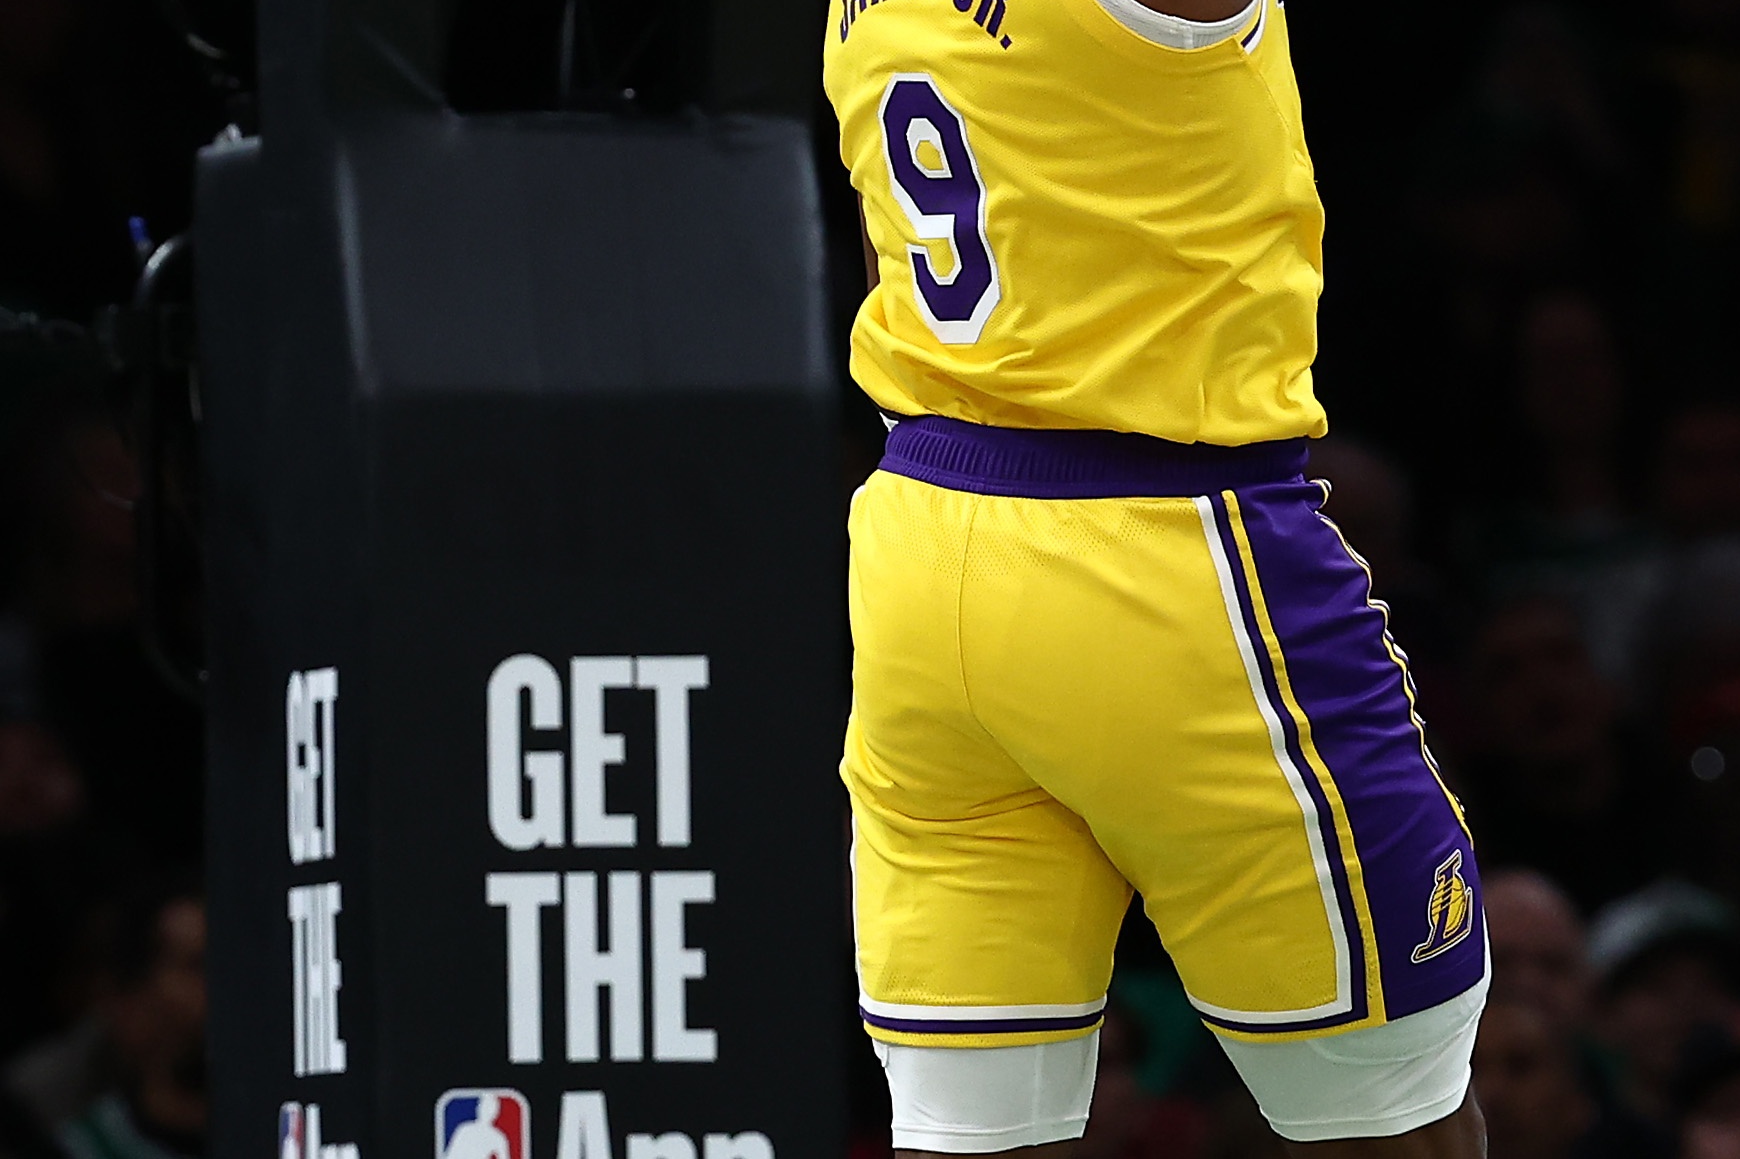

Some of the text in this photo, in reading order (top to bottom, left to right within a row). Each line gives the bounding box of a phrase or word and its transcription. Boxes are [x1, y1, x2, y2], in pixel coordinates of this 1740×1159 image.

[879, 72, 1002, 344] 9
[486, 653, 709, 851] GET
[485, 870, 718, 1064] THE
